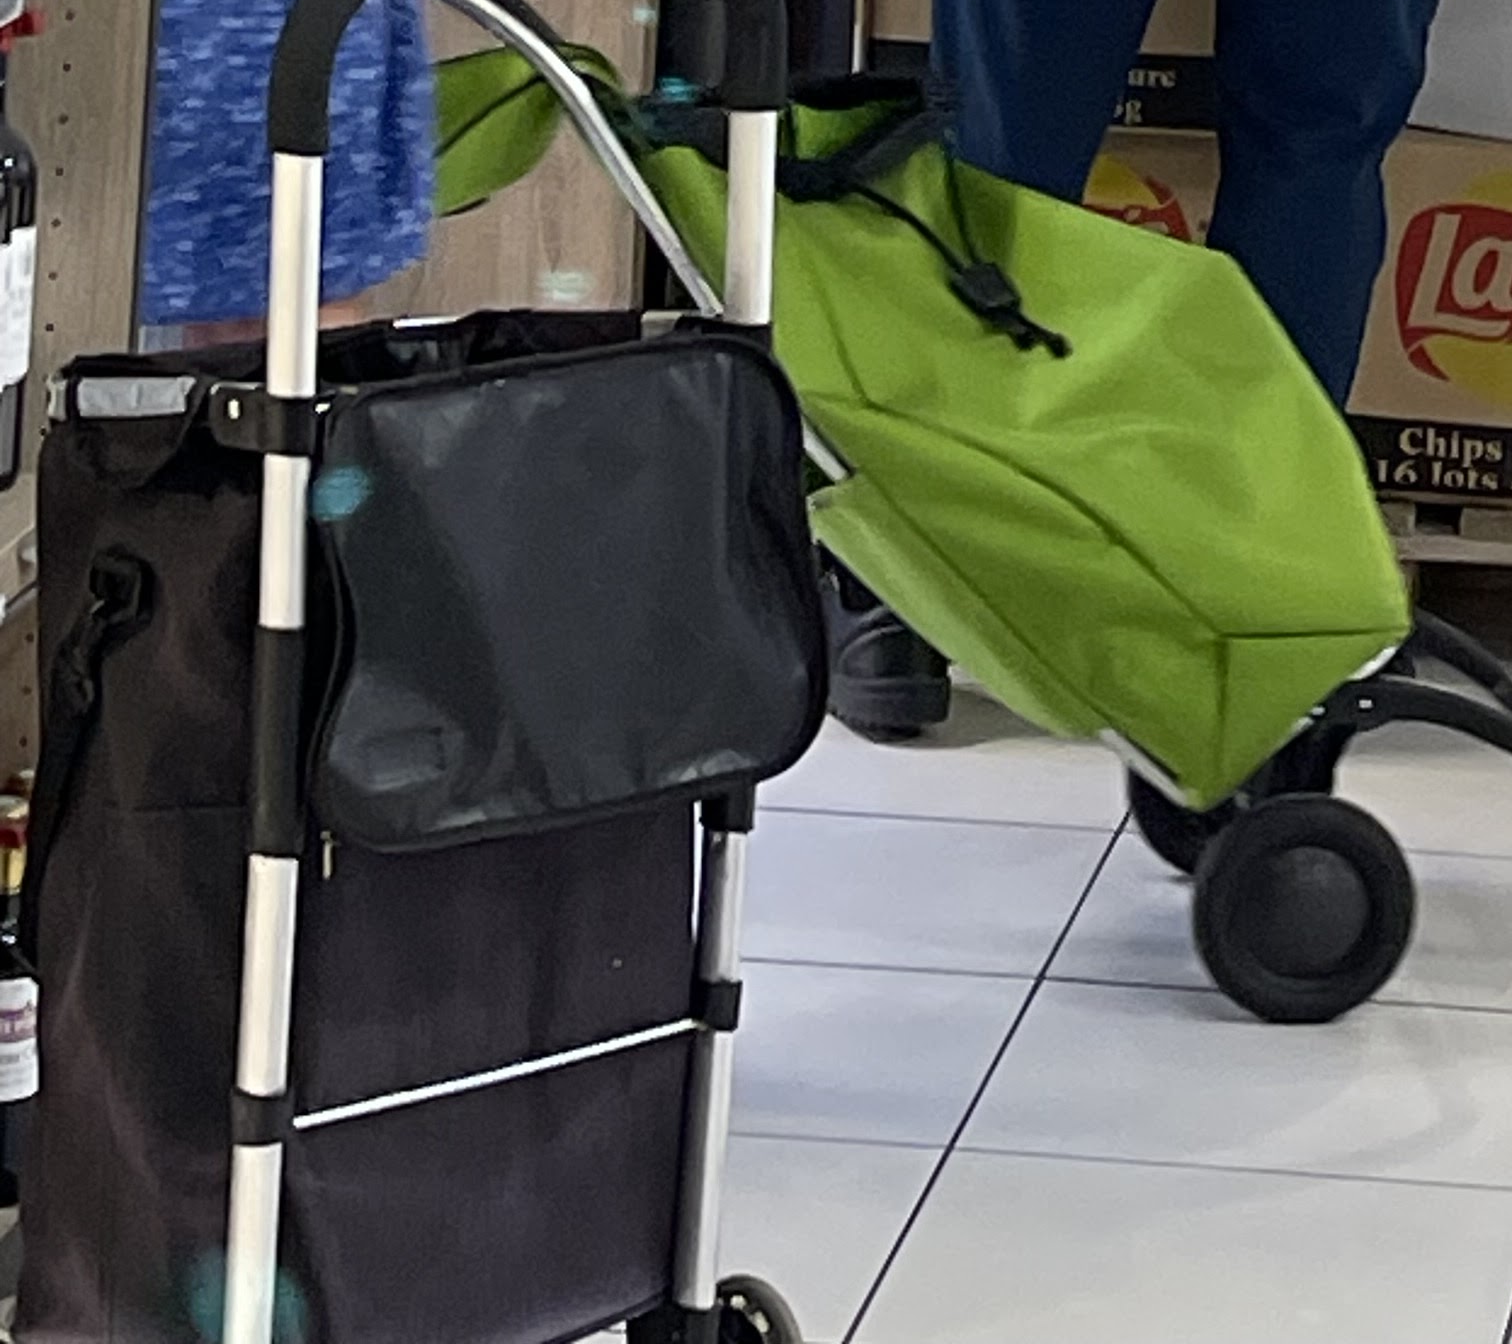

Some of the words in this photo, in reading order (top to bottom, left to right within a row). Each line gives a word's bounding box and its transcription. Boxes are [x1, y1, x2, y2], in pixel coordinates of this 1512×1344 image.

[1399, 427, 1503, 468] Chips
[1376, 459, 1418, 485] 16
[1431, 461, 1499, 491] lots
